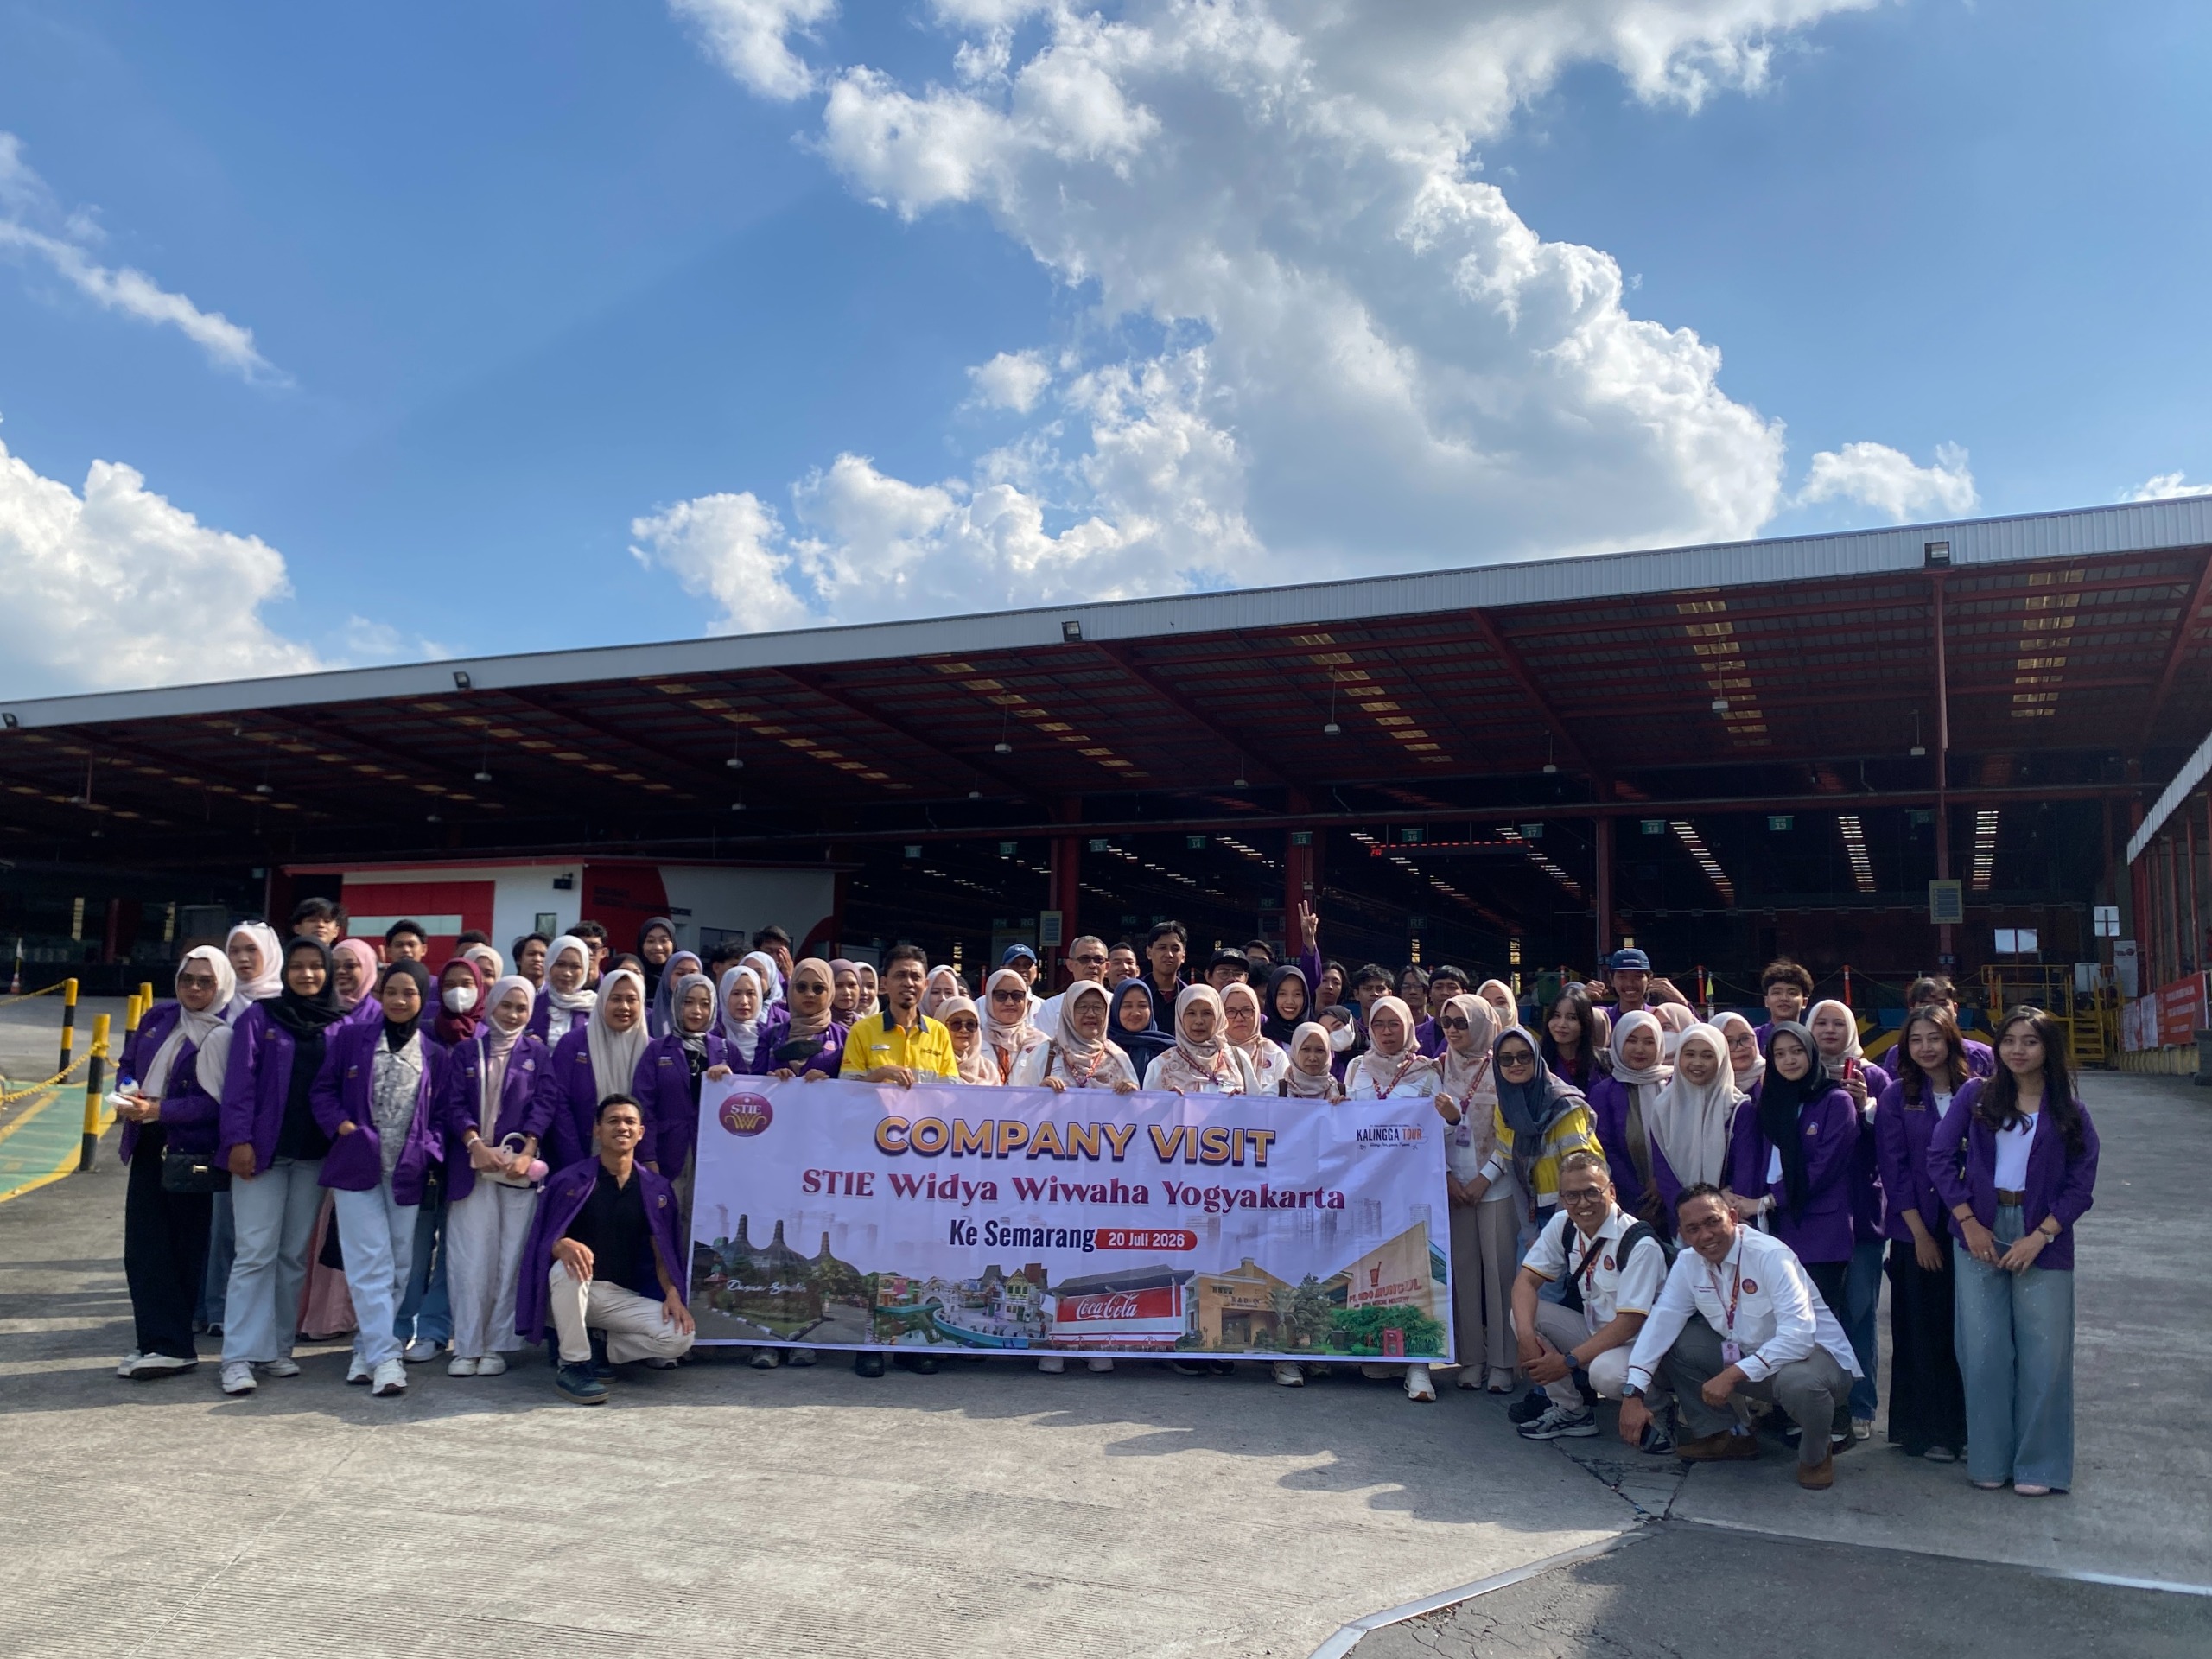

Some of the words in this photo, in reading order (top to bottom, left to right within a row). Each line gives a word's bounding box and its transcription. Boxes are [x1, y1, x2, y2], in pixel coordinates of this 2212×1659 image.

[1261, 899, 1274, 907] RF
[1410, 918, 1425, 927] RE
[730, 1104, 762, 1115] STIE
[874, 1116, 1136, 1161] COMPANY
[1148, 1125, 1275, 1166] VISIT
[1357, 1128, 1399, 1141] KALINGGA
[1402, 1128, 1422, 1141] TOUR
[802, 1169, 875, 1197] STIE
[887, 1173, 998, 1207] Widya
[1012, 1175, 1149, 1205] Wiwaha
[1162, 1180, 1345, 1214] Yogyakarta
[950, 1219, 978, 1246] Ke
[984, 1220, 1096, 1253] Semarang
[1109, 1232, 1125, 1246] 20
[1128, 1232, 1148, 1246] Juli
[1152, 1233, 1185, 1248] 2026
[1375, 1278, 1421, 1299] MUNCUL
